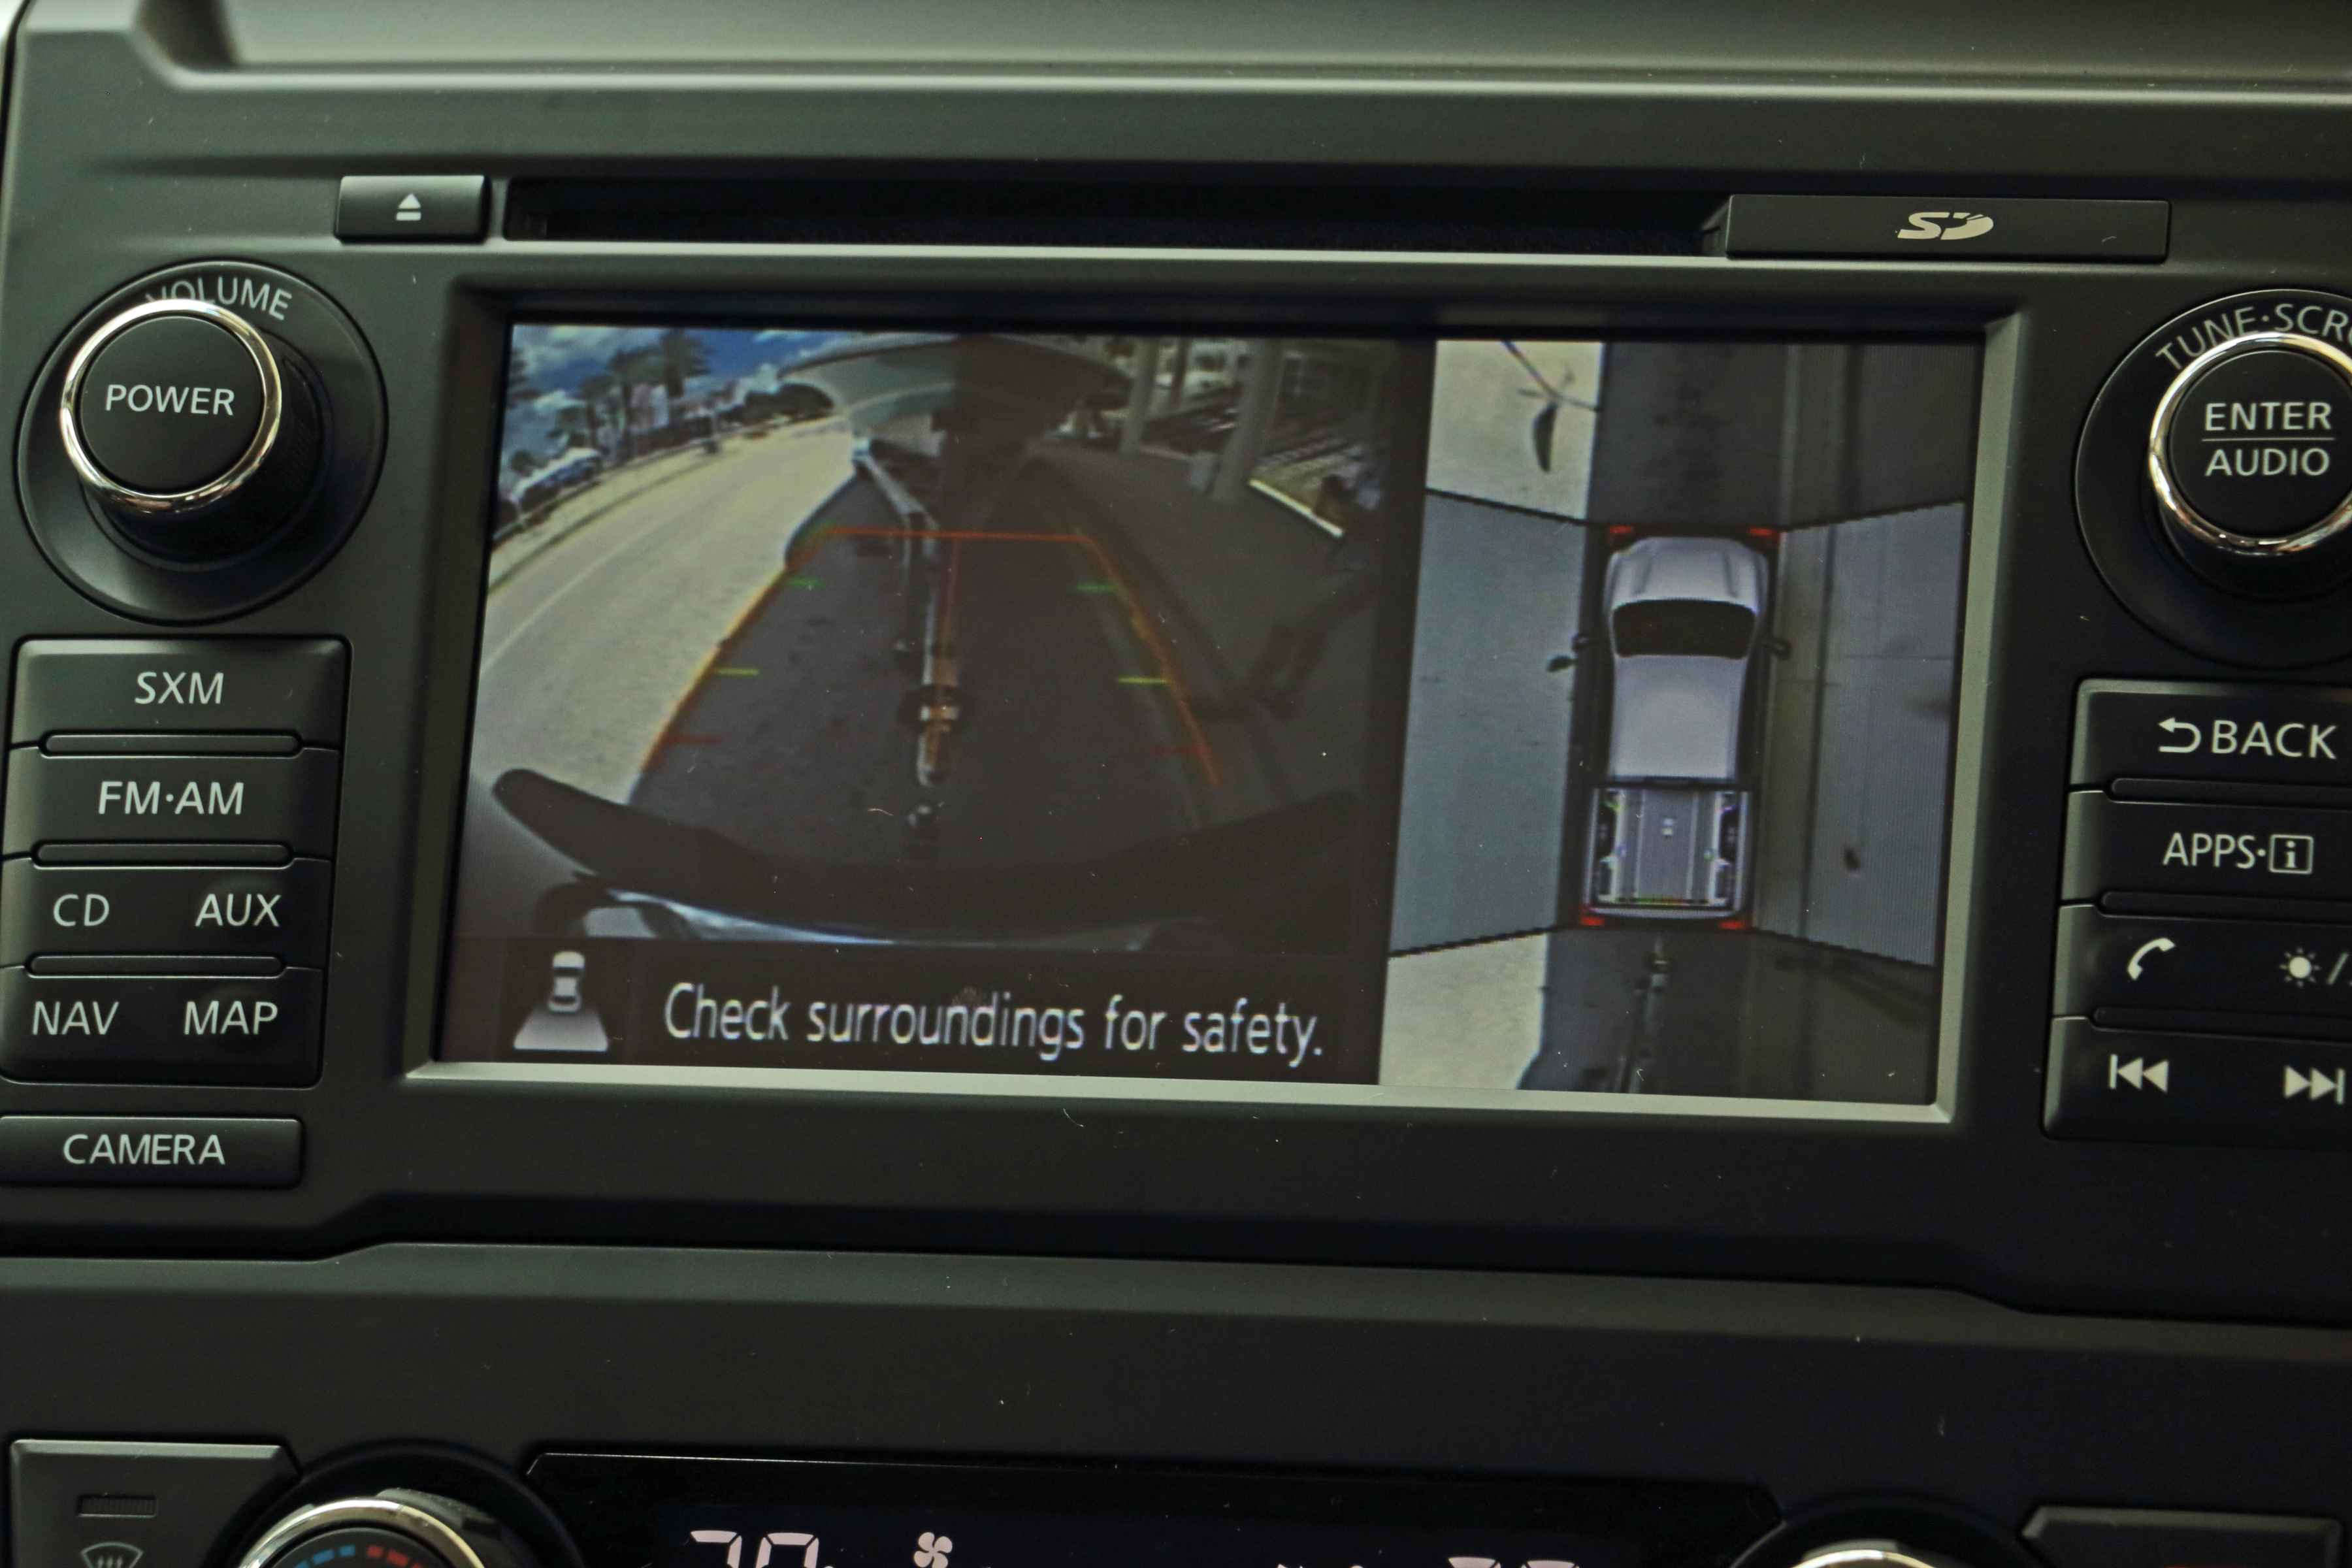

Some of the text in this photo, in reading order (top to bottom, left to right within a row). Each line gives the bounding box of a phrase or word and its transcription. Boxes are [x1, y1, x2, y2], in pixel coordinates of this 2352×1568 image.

[105, 384, 235, 416] POWER
[2204, 401, 2332, 431] ENTER
[2204, 447, 2330, 476] AUDIO
[134, 671, 224, 705] SXM
[2212, 719, 2336, 759] BACK
[53, 893, 281, 927] CD AUX
[32, 1000, 278, 1036] NAV MAP
[664, 981, 1324, 1068] Check surroundings for safety.
[63, 1134, 225, 1165] CAMERA
